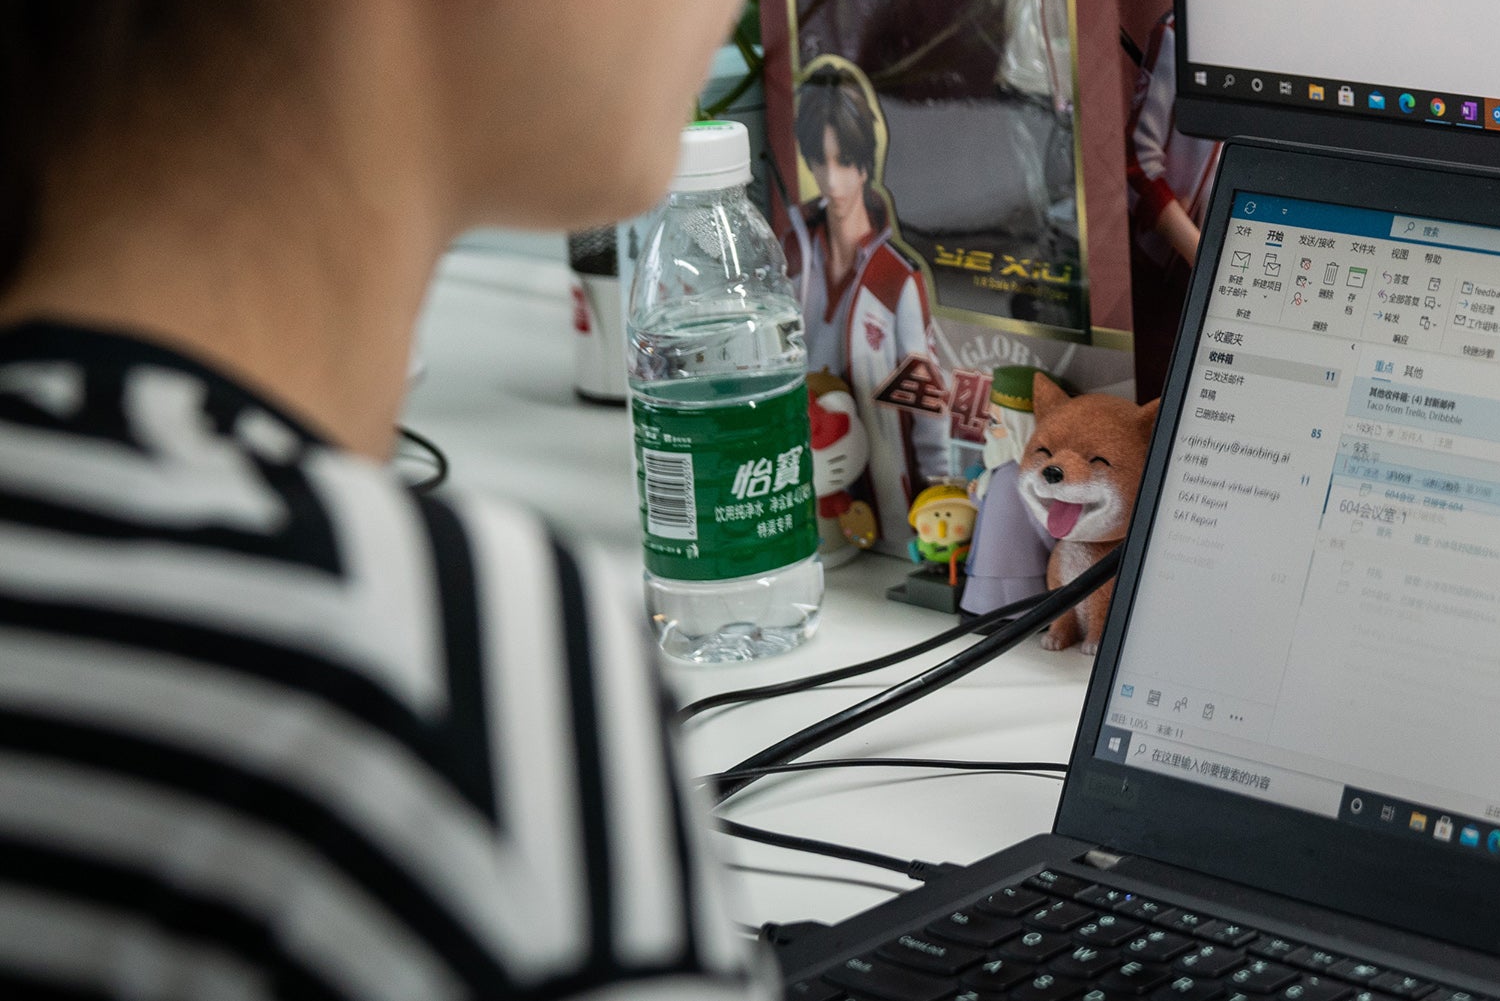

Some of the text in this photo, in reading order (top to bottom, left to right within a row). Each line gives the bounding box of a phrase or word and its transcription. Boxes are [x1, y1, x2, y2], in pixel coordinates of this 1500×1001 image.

[1235, 225, 1442, 265] 文件 开始 发送/接收 文件夹 视图 帮助
[1228, 274, 1244, 286] 新建
[1252, 277, 1283, 292] 新建项目
[1218, 285, 1249, 299] 电子邮件
[1213, 329, 1243, 346] 收藏夹
[1208, 351, 1335, 381] 收件箱 11
[1375, 360, 1423, 378] 重点 其他
[1204, 370, 1244, 386] 已发送邮件
[1199, 388, 1216, 400] 草稿
[1411, 394, 1422, 405] (4)
[1367, 400, 1462, 425] Taco from Trello, Dribbble
[1194, 407, 1321, 438] 已删除邮件 85
[1190, 513, 1217, 528] Report
[1129, 716, 1149, 731] 1,055
[1151, 749, 1273, 791] 在这里输入你要搜索的内容
[1072, 946, 1099, 962] W
[982, 959, 1004, 975] A
[1120, 960, 1144, 976] E
[1032, 973, 1055, 990] S
[1171, 976, 1195, 992] R
